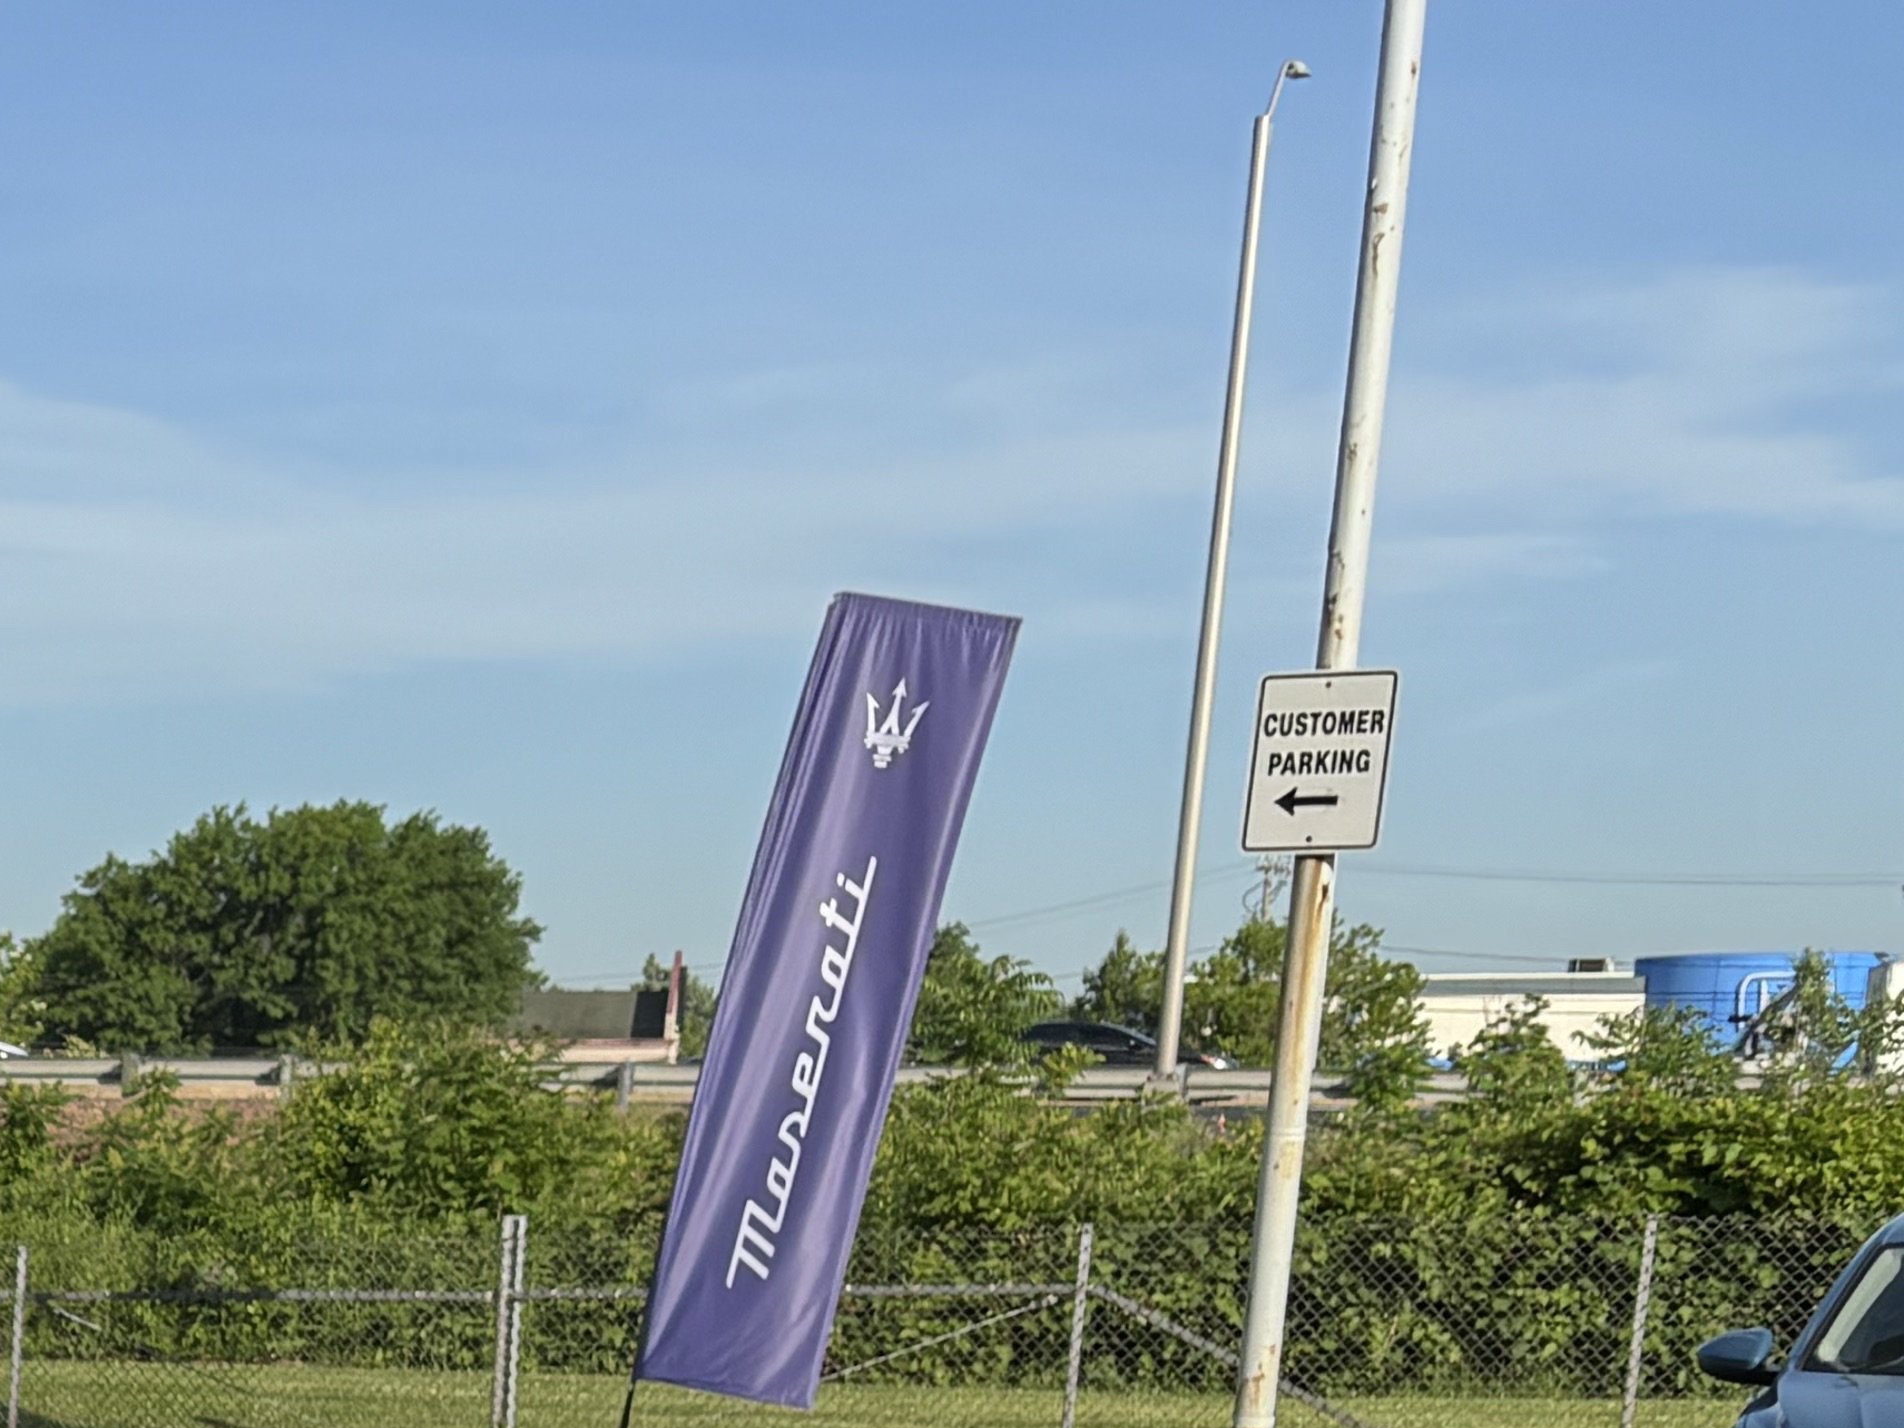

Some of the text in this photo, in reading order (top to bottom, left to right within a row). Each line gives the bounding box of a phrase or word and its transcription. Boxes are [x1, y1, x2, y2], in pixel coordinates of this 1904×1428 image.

[1263, 710, 1385, 737] CUSTOMER
[1267, 749, 1371, 776] PARKING
[725, 855, 879, 1289] Maserati
